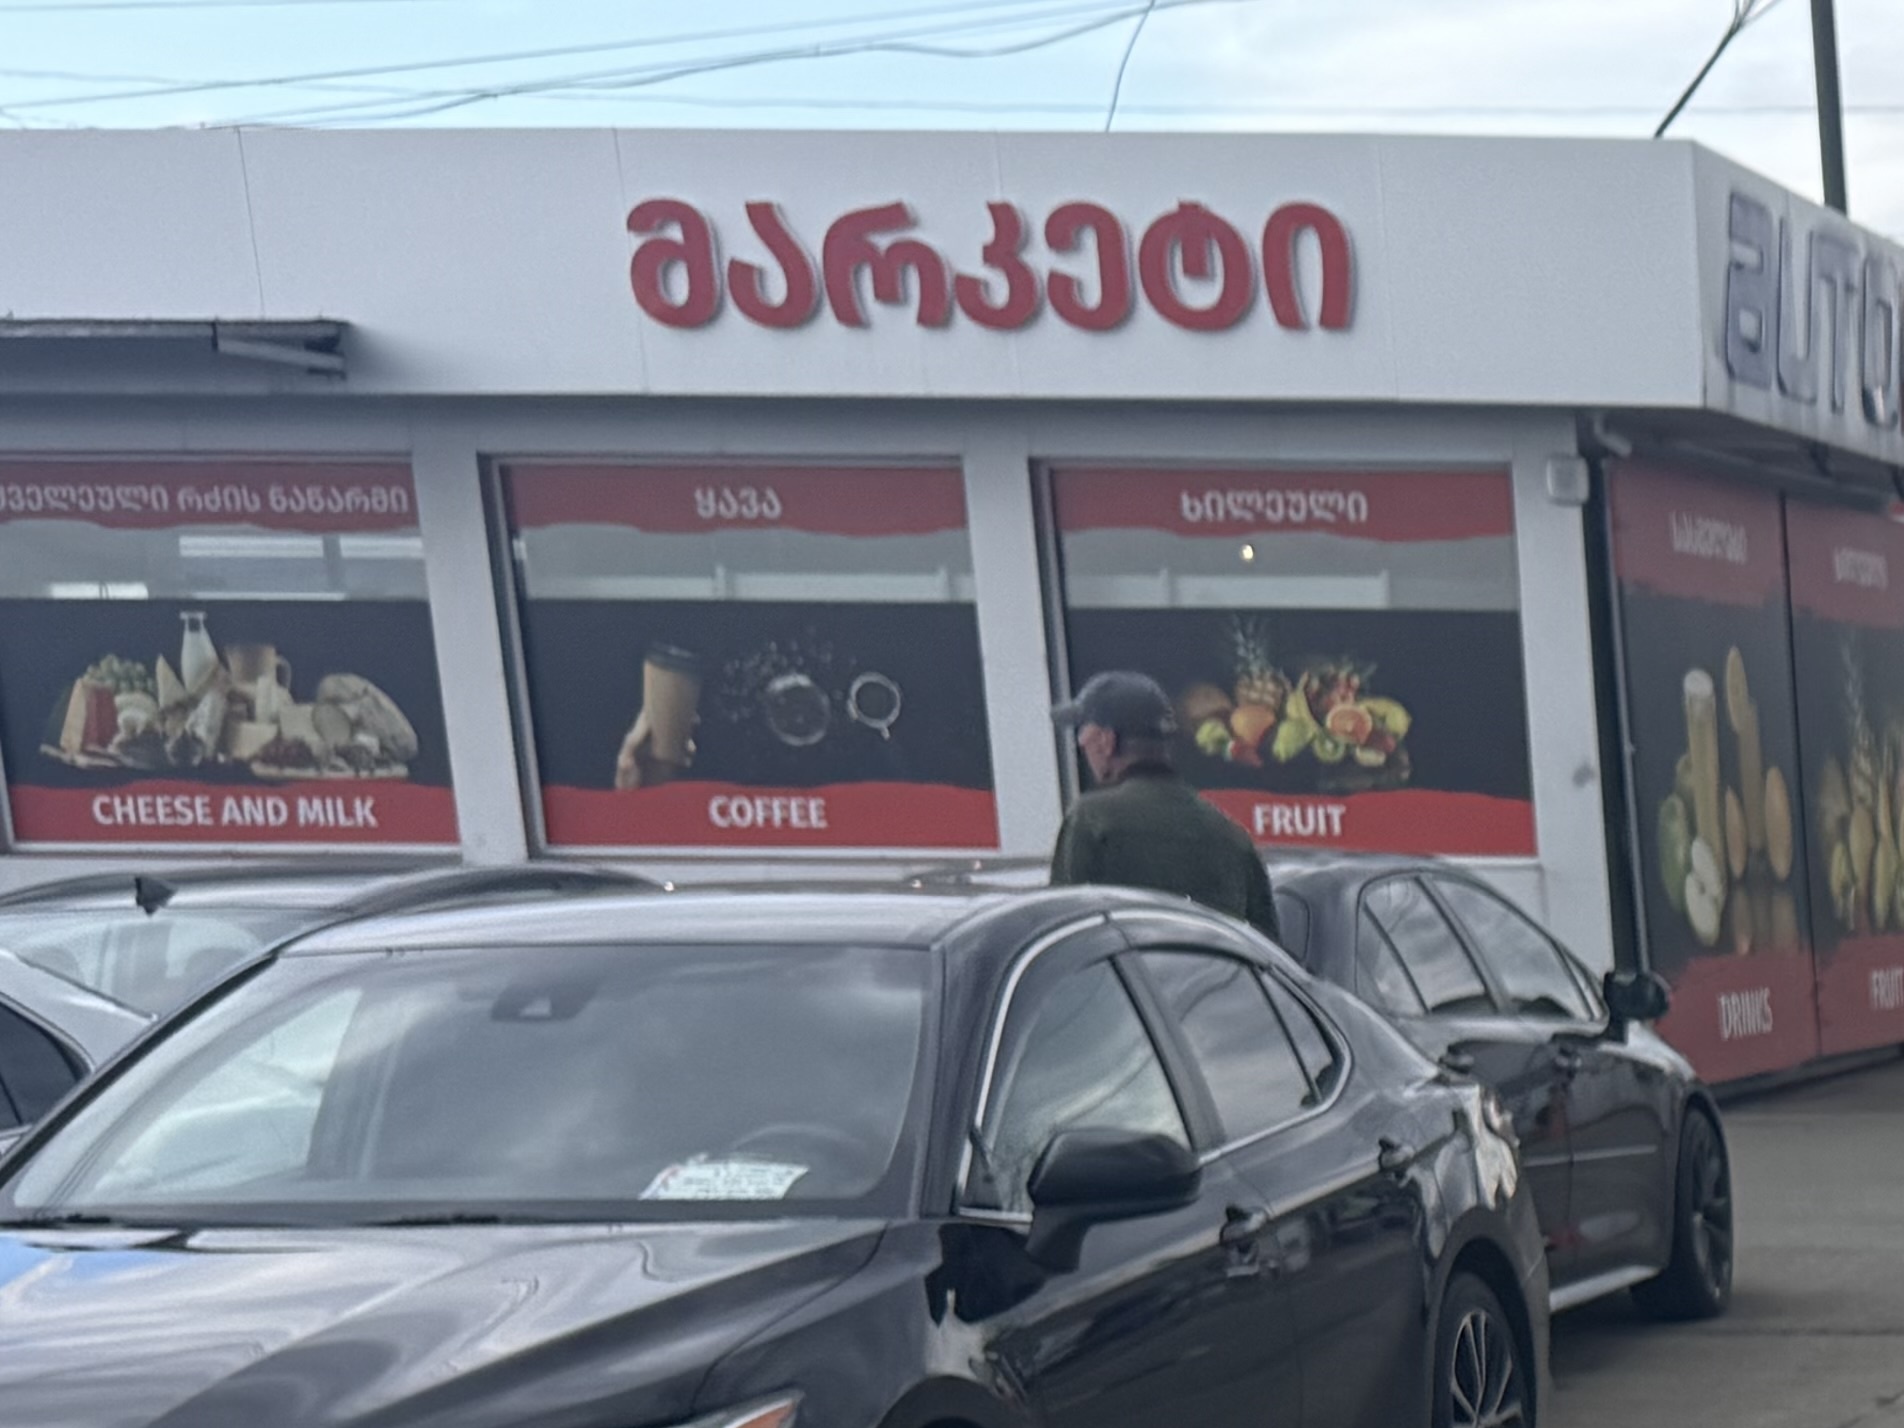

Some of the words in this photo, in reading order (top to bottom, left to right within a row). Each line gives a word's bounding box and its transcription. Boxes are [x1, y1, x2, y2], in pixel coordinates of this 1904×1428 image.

[627, 199, 1354, 332] მარკეტი
[0, 484, 169, 513] ველეული
[694, 487, 783, 520] ყავა
[1179, 492, 1368, 523] ხილეული
[92, 795, 213, 826] CHEESE
[221, 797, 288, 827] AND
[297, 797, 378, 828] MILK
[708, 796, 828, 829] COFFEE
[1253, 803, 1347, 837] FRUIT
[1869, 966, 1904, 1009] FRUIT
[1717, 987, 1773, 1040] DRINKS
